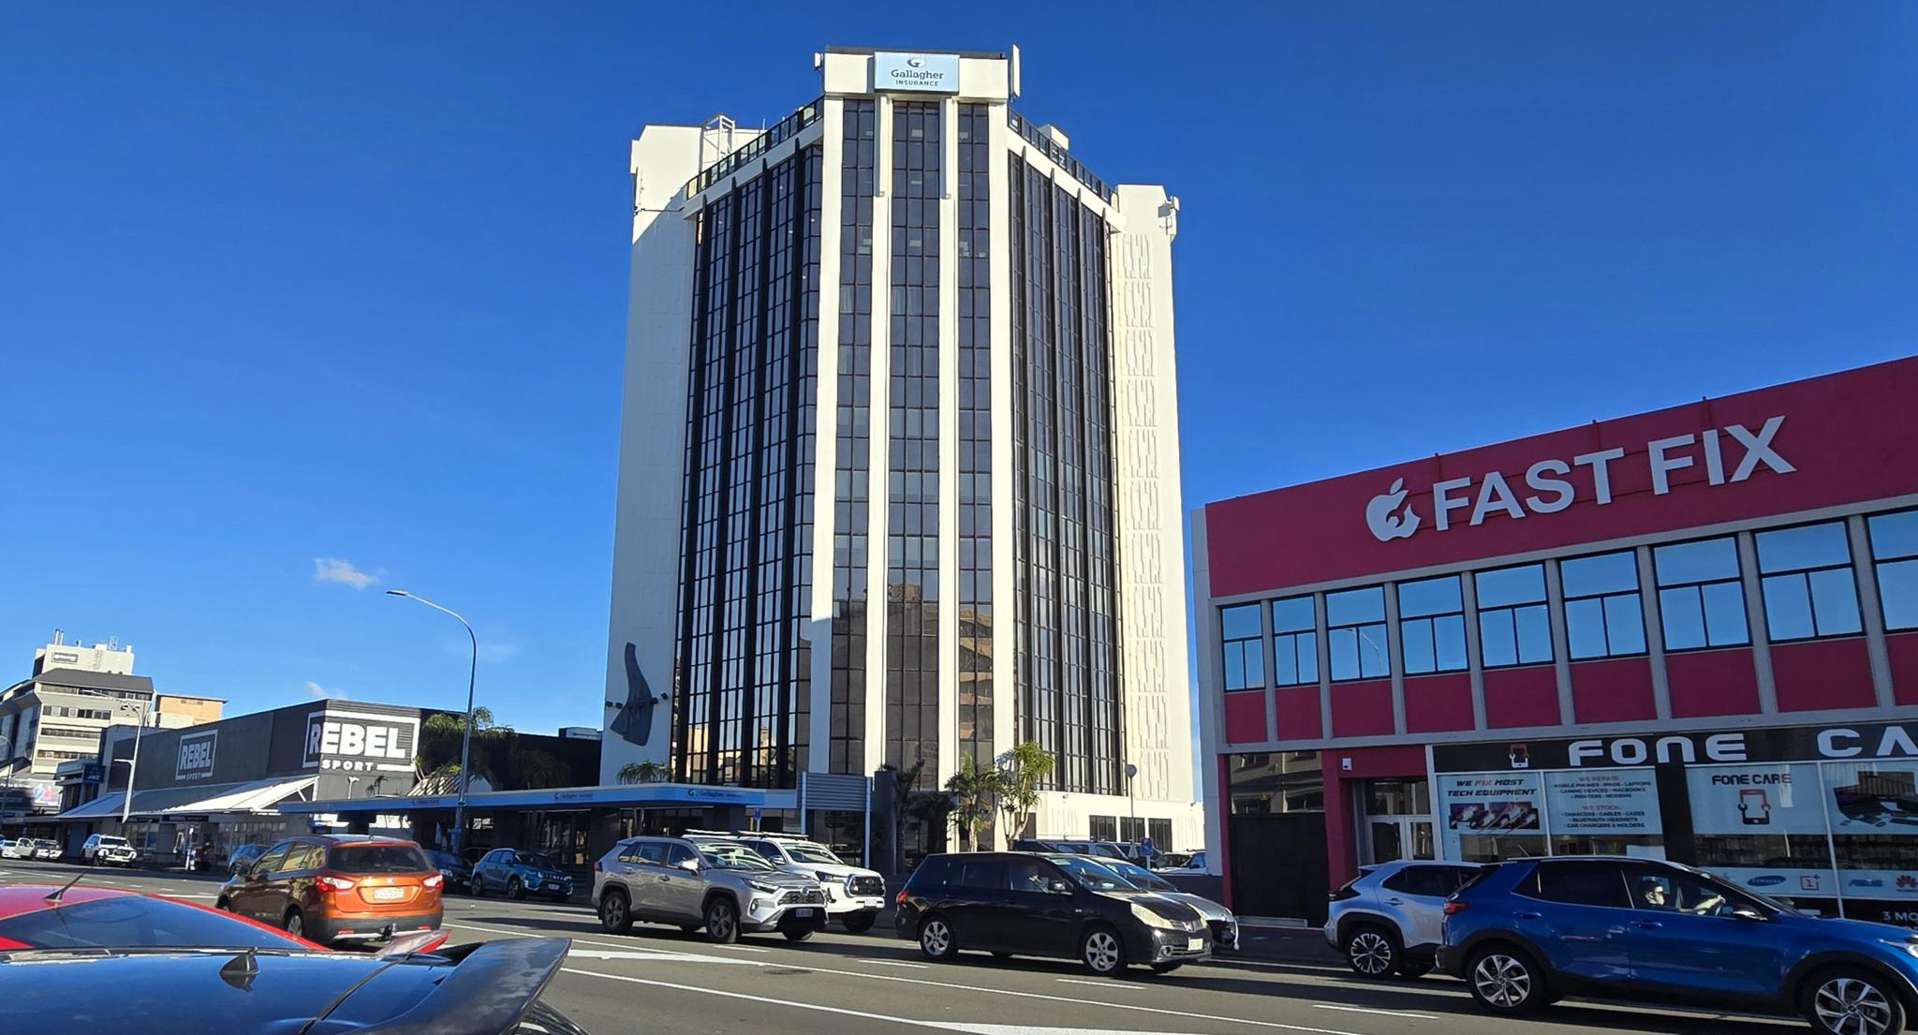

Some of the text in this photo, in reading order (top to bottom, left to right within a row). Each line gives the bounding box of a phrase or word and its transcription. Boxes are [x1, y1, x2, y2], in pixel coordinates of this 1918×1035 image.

[890, 69, 944, 80] Gallagher
[895, 79, 939, 87] INSURANCE
[1432, 415, 1798, 531] FAST FIX
[309, 721, 406, 758] REBEL
[1568, 726, 1918, 766] FONE CA
[180, 741, 211, 770] REBEL
[322, 760, 374, 771] SPORT
[1494, 779, 1524, 787] MOST
[1712, 773, 1792, 785] FONE CARE
[1475, 789, 1537, 797] EQUIPMENT
[1882, 911, 1891, 920] 3
